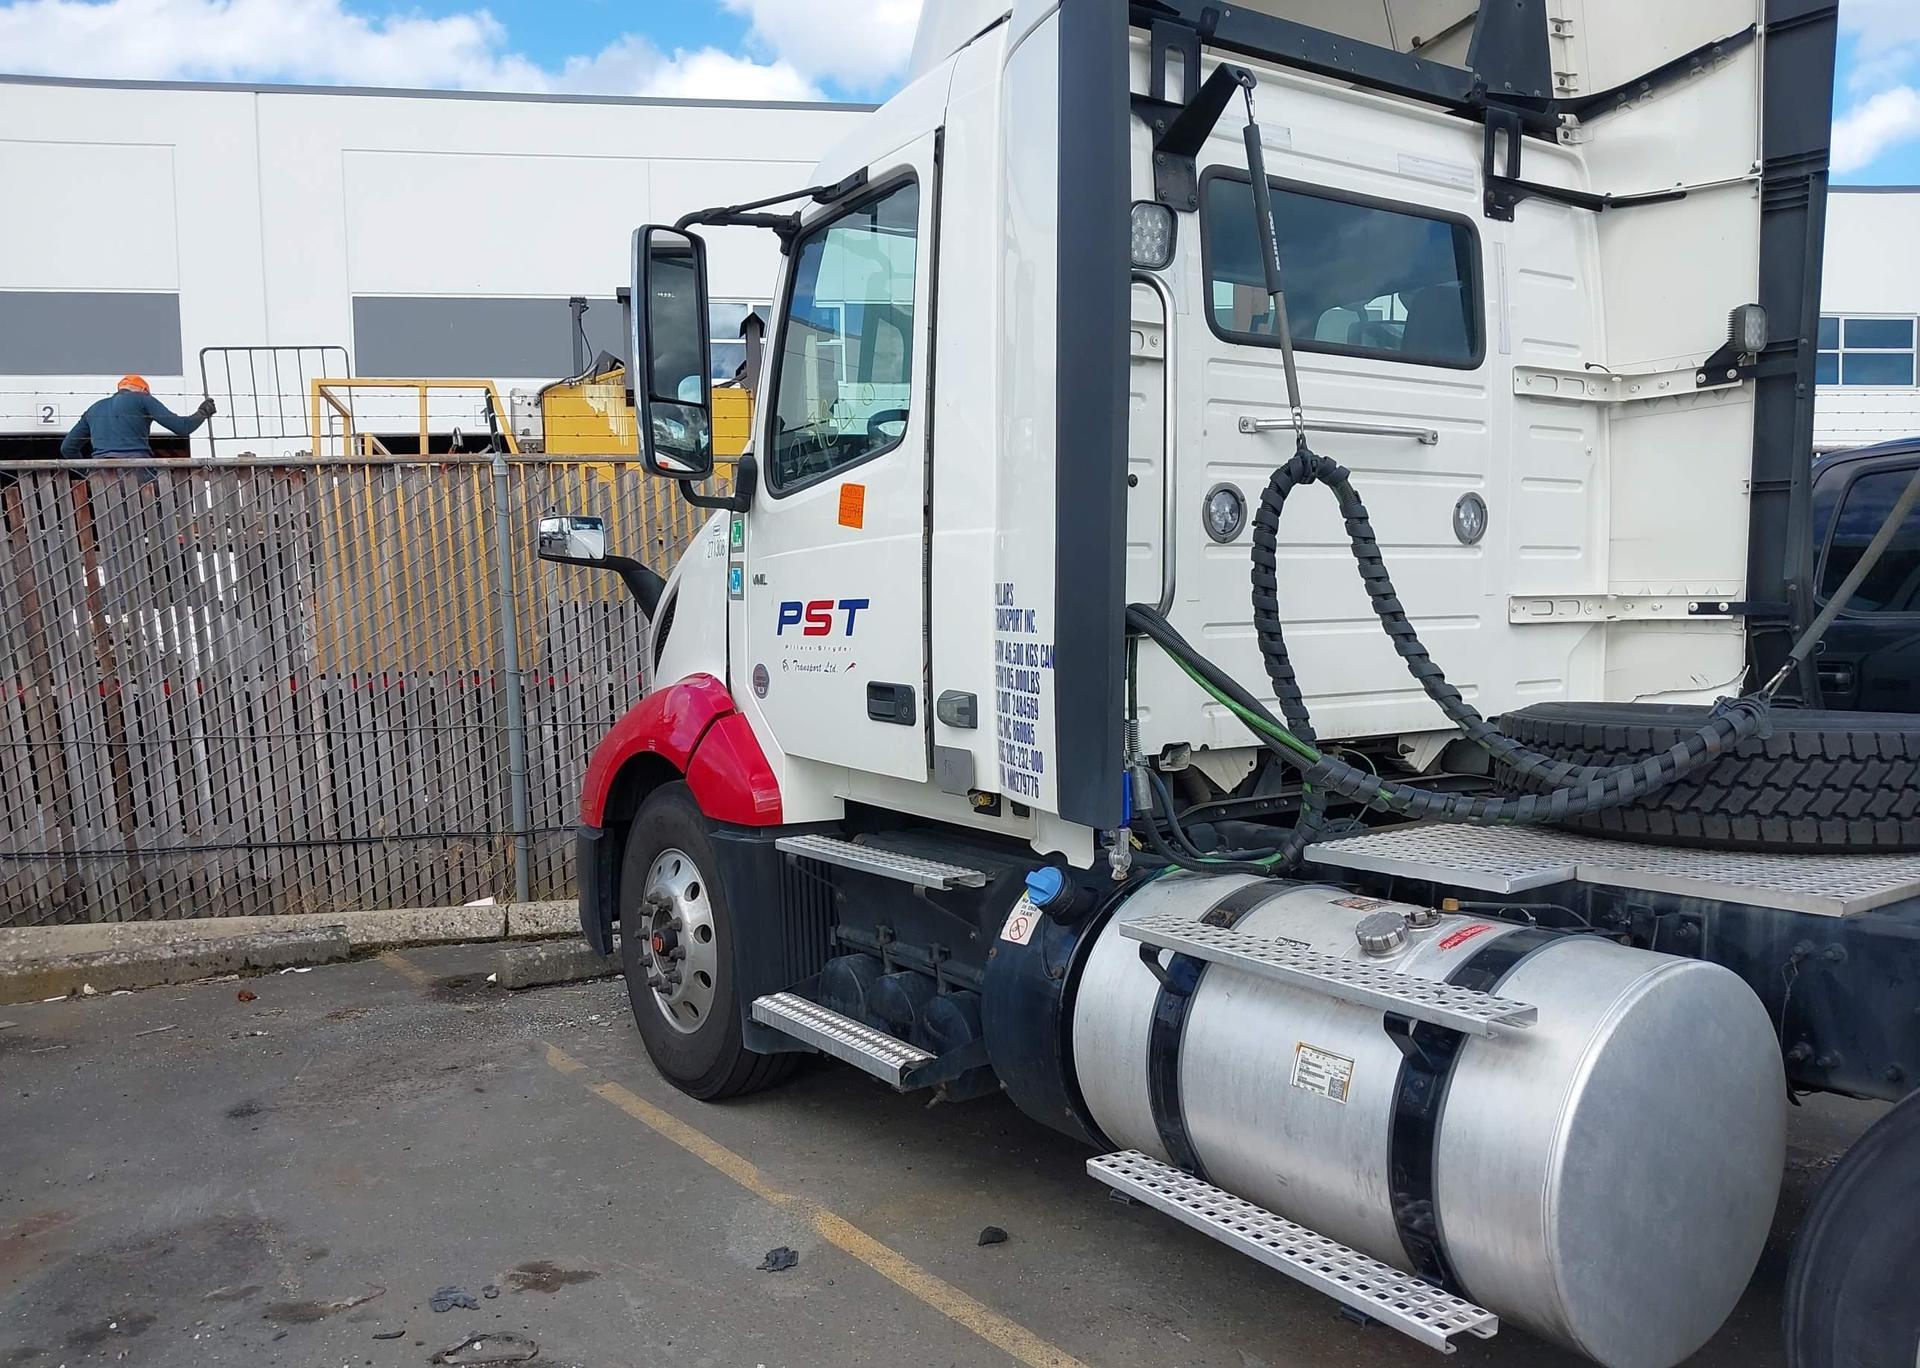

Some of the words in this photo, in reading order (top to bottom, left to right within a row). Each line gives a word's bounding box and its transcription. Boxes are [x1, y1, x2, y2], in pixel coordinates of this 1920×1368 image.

[42, 406, 54, 423] 2
[480, 407, 488, 424] 1
[777, 599, 870, 637] PST
[1025, 643, 1039, 668] KGS
[1040, 643, 1056, 669] CAN
[793, 659, 822, 675] Transport
